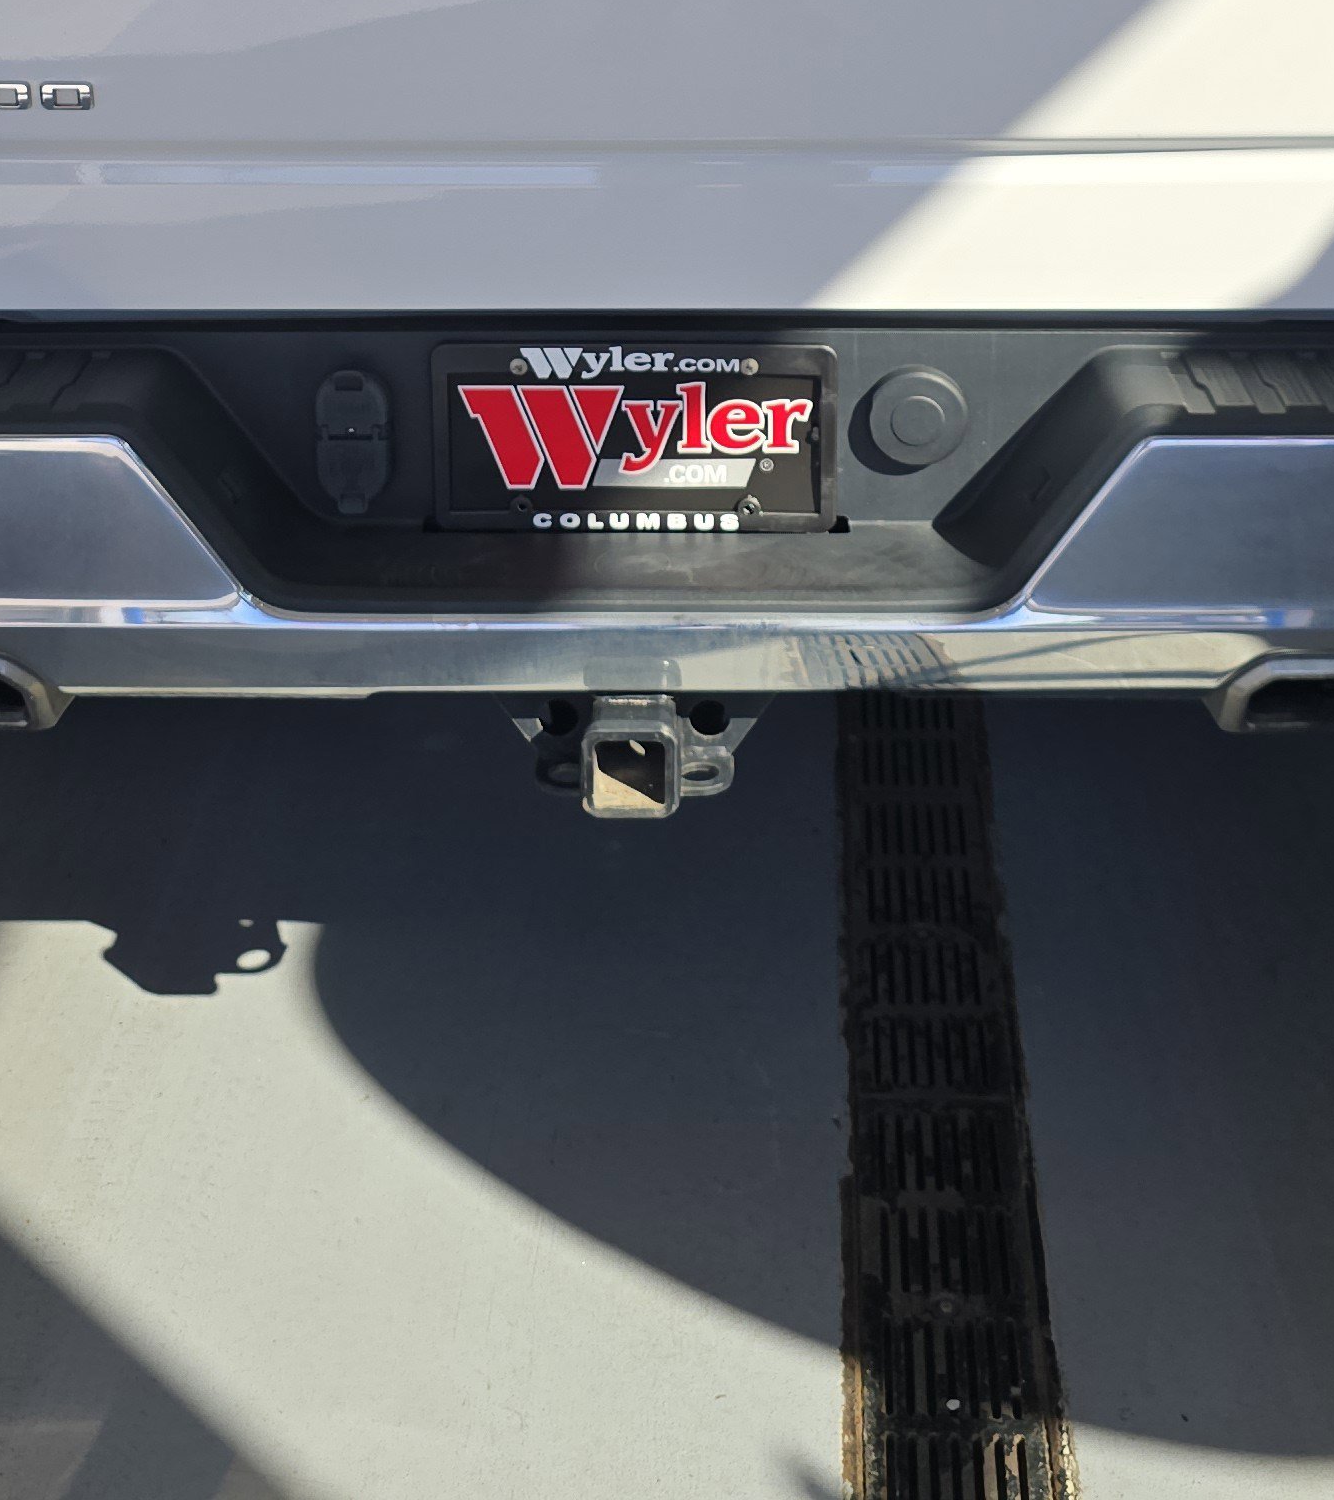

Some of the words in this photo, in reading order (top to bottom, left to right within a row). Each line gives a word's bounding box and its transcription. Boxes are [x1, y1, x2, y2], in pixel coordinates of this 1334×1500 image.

[457, 381, 814, 491] Wyler
[663, 463, 727, 485] .COM
[532, 511, 740, 531] COLUMBUS
